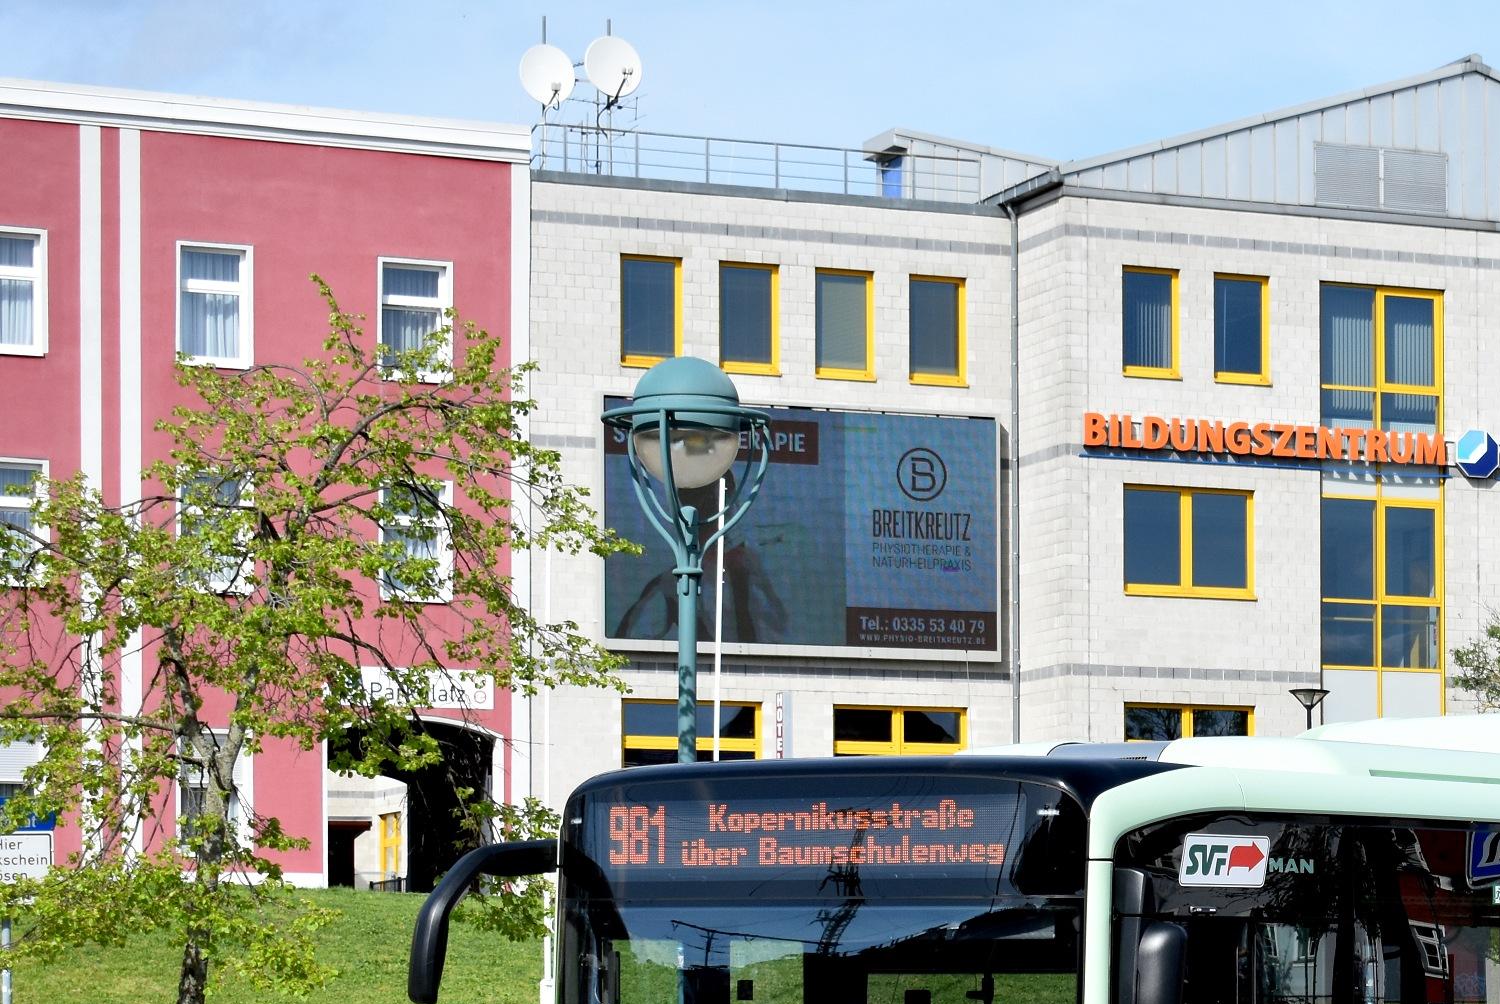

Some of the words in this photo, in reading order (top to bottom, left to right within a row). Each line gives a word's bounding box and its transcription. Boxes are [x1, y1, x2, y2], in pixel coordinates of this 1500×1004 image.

[1083, 412, 1447, 466] BILDUNGSZENTRUM
[872, 509, 971, 541] BREITKREUTZ
[872, 542, 961, 557] PHYSIOTHERAPIE
[964, 545, 972, 557] &
[872, 556, 972, 572] NATURHEILPRAXIS
[860, 616, 889, 631] Tel.:
[893, 617, 925, 632] 0335
[929, 618, 945, 633] 53
[949, 619, 965, 634] 40
[969, 620, 986, 634] 79
[370, 682, 467, 703] Parklatz
[709, 799, 975, 834] Kopernikusstraße
[609, 805, 665, 865] 981
[681, 838, 747, 866] über
[758, 835, 1004, 866] Baumschulenweg
[1185, 844, 1229, 876] SVF
[1268, 857, 1315, 874] MAN
